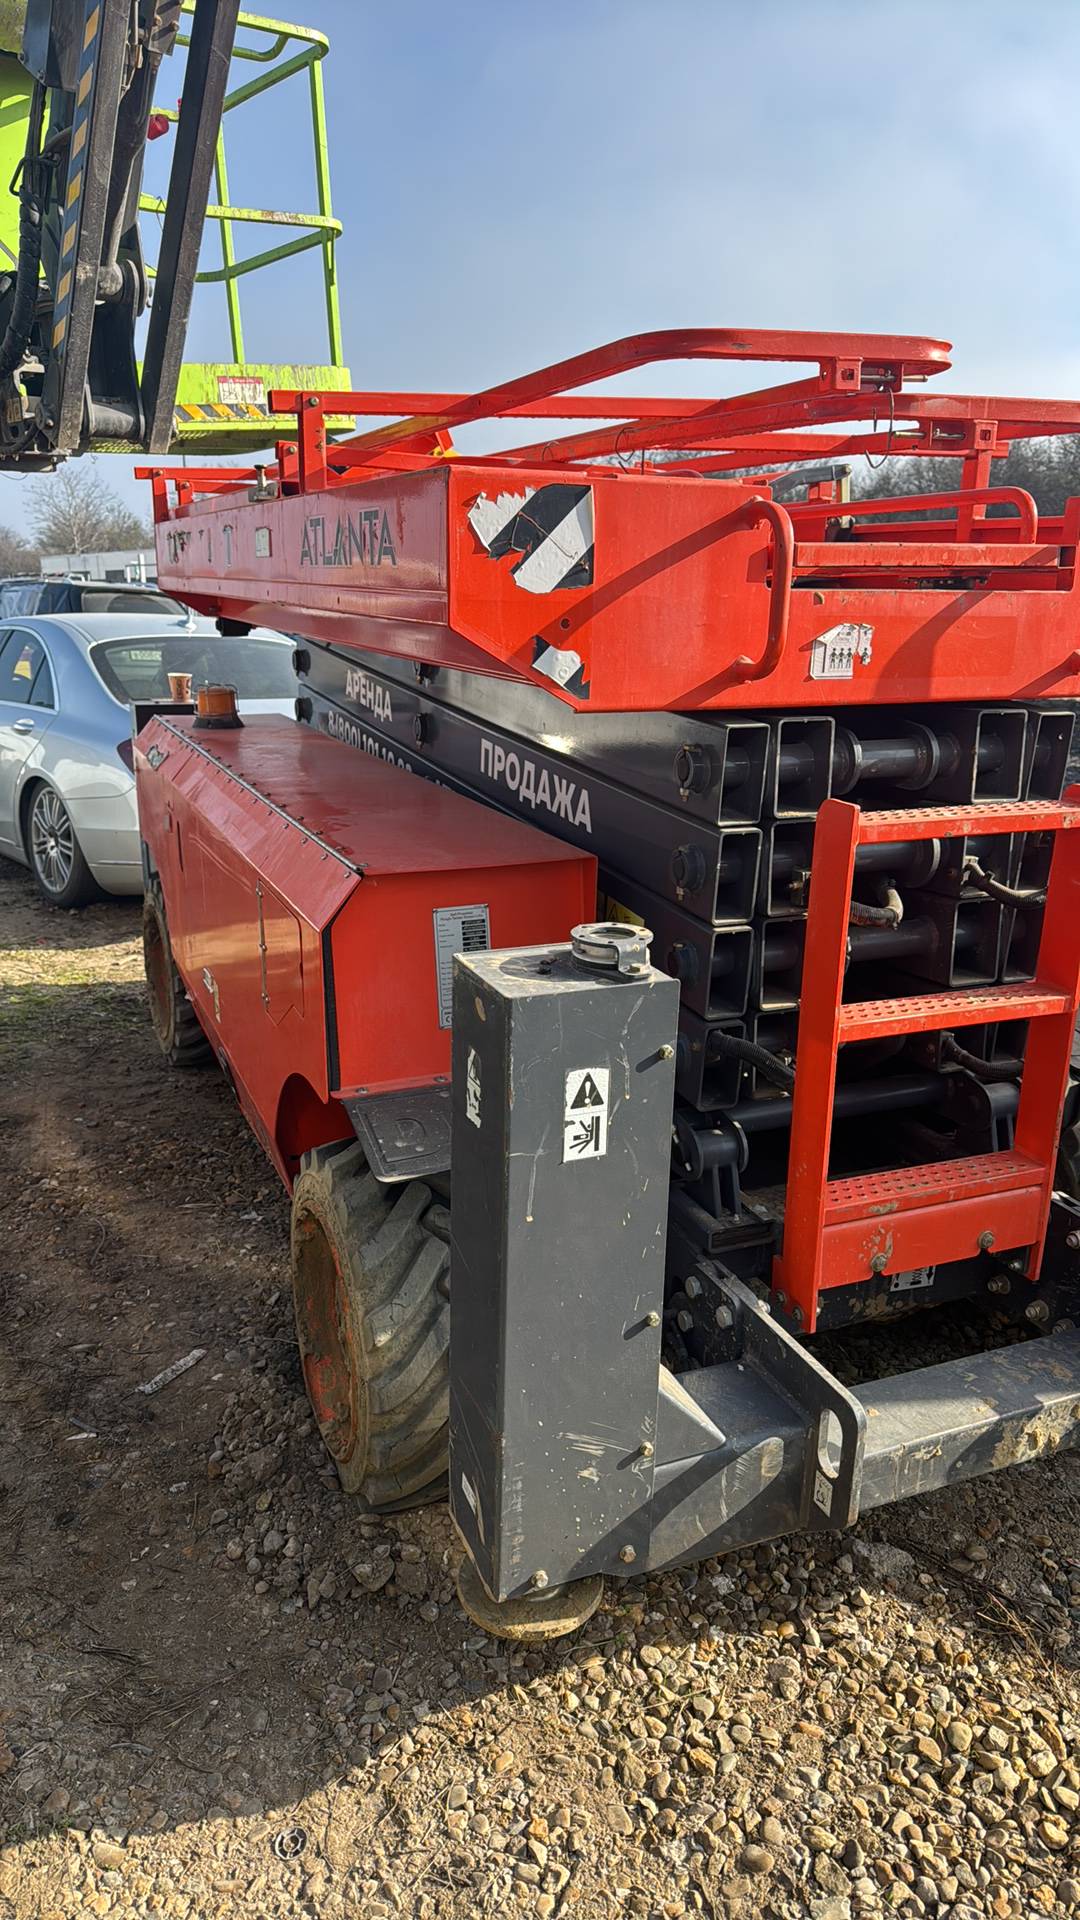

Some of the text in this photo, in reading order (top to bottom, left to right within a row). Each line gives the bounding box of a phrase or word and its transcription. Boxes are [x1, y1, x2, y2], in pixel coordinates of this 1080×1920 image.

[300, 508, 398, 567] ATLANTA
[345, 669, 392, 722] АРЕНДА
[480, 738, 592, 833] ПРОДАЖА
